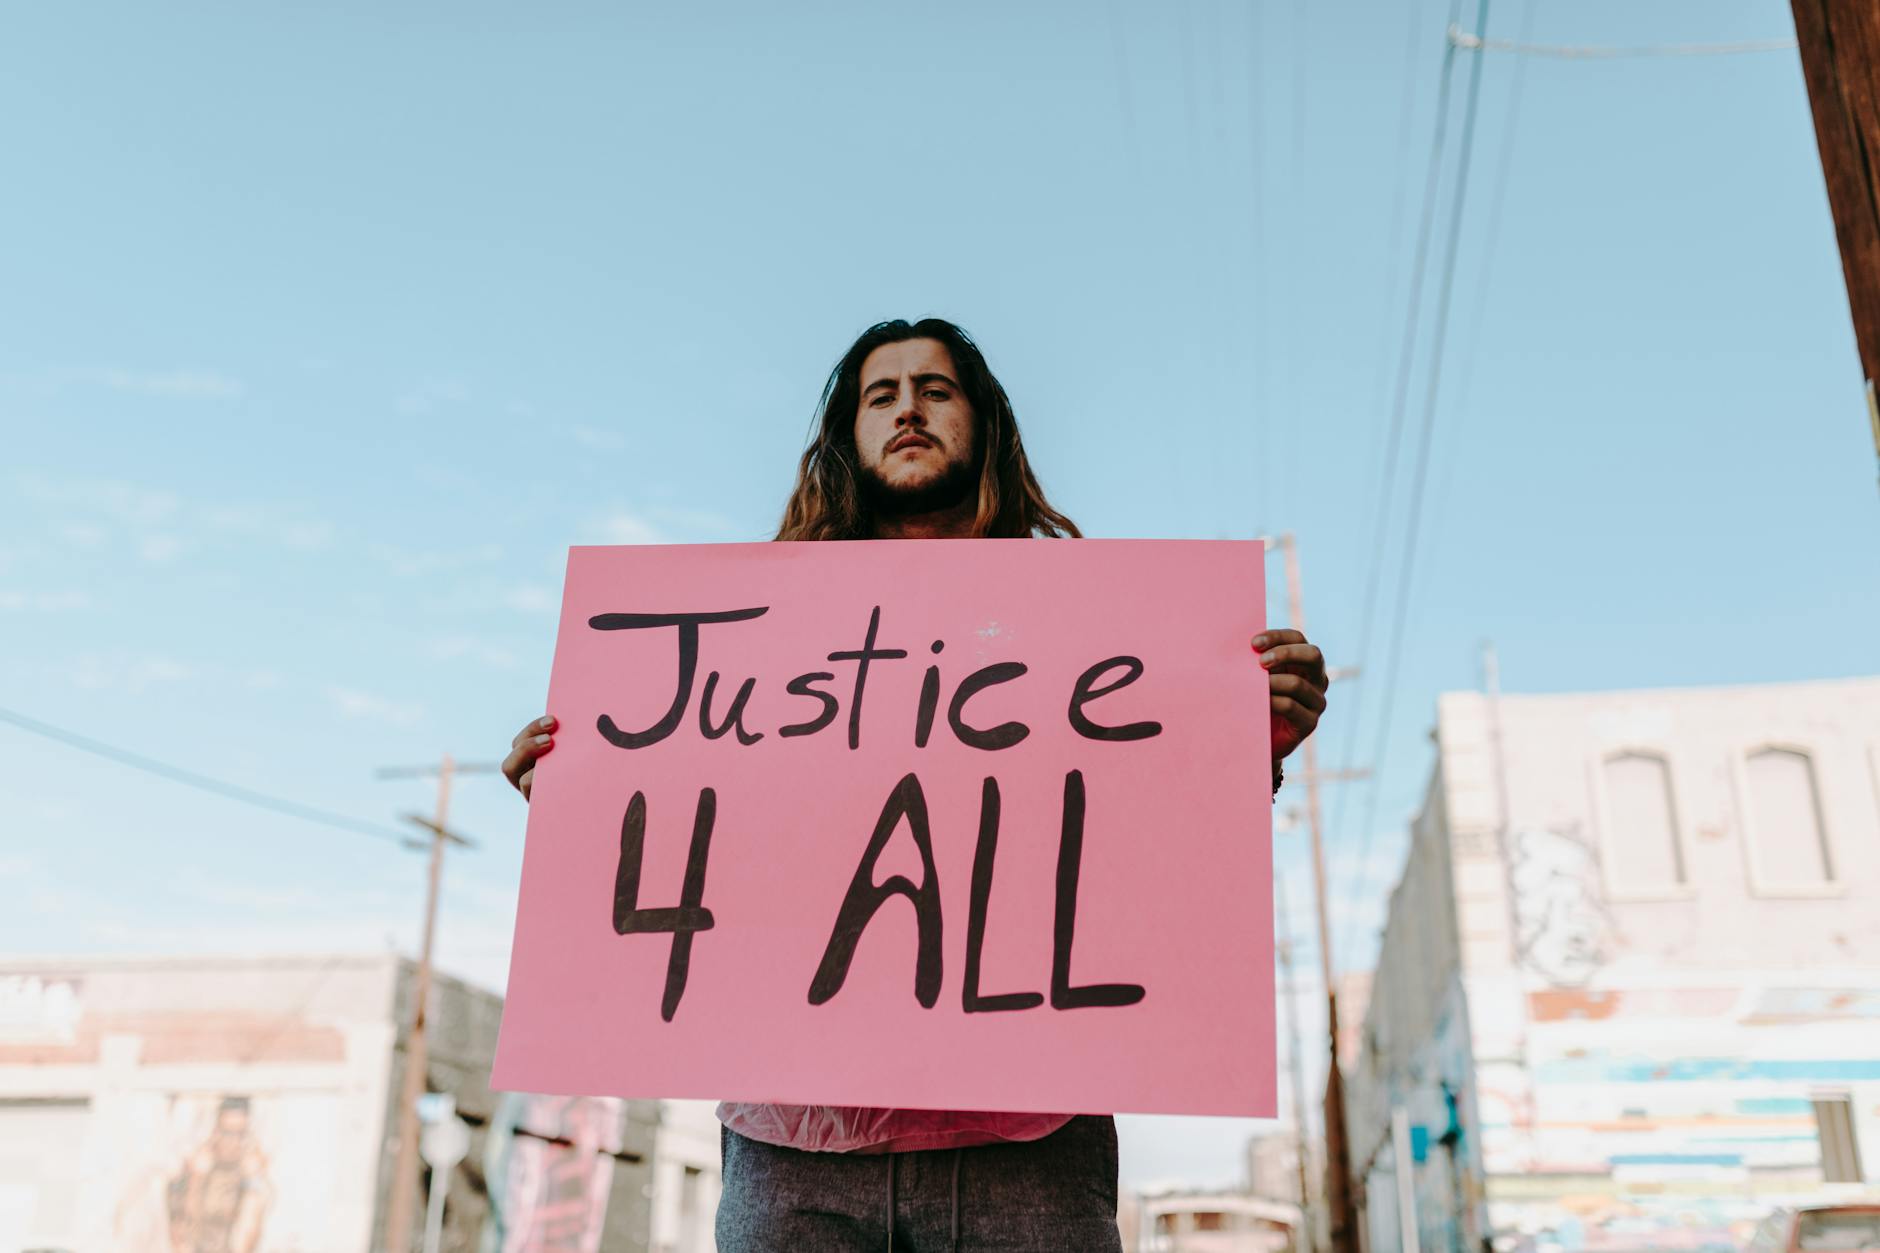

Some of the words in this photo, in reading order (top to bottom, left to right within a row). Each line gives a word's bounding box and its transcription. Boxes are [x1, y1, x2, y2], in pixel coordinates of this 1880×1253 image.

[588, 606, 1163, 751] Justice
[613, 788, 717, 1023] 4
[808, 769, 1146, 1014] ALL
